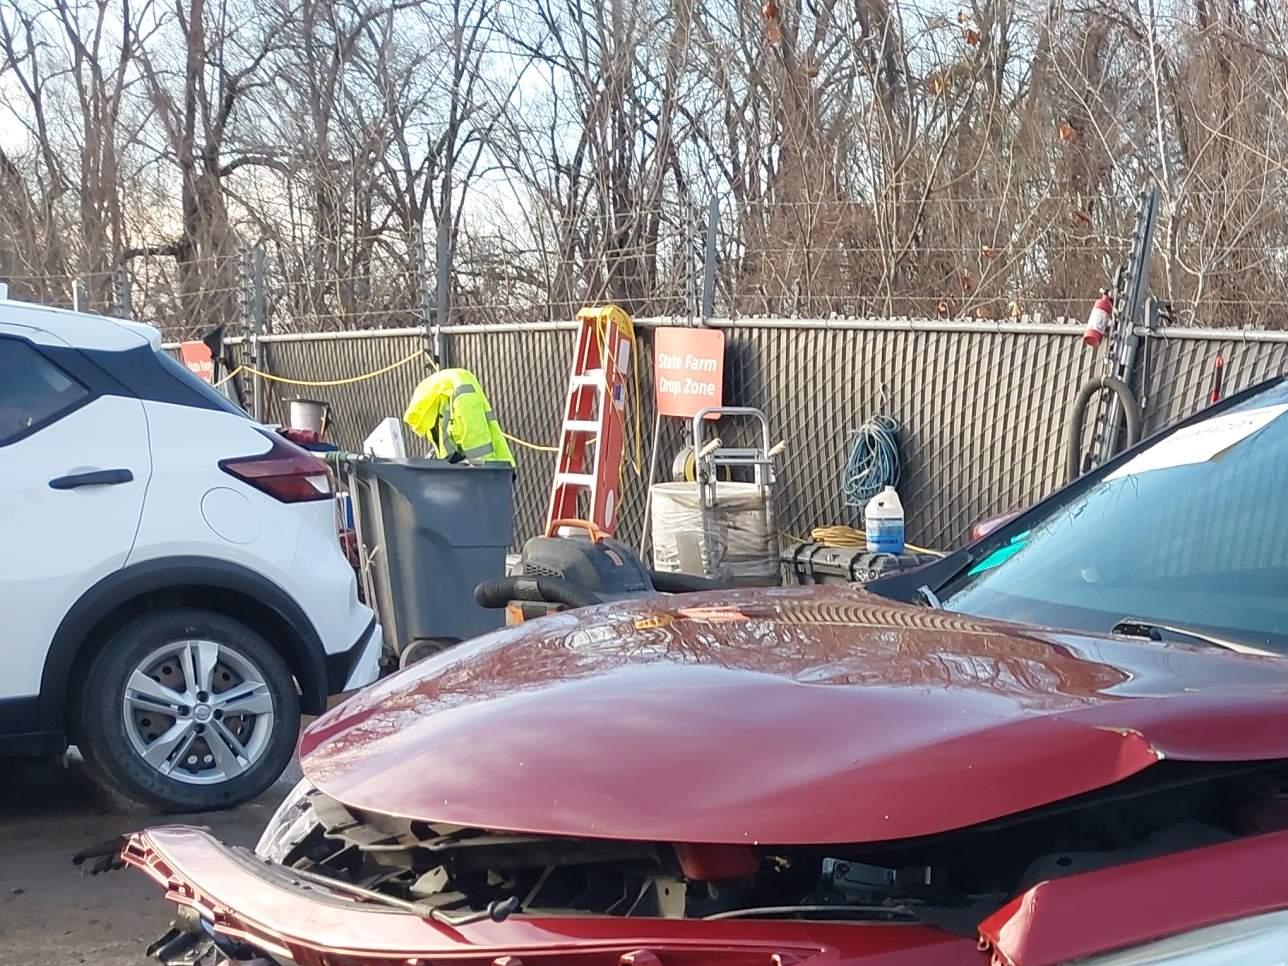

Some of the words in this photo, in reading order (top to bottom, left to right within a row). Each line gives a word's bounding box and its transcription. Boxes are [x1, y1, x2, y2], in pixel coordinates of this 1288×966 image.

[658, 352, 682, 369] State
[684, 353, 717, 371] Farm
[659, 376, 681, 397] Drop
[683, 377, 715, 396] Zone
